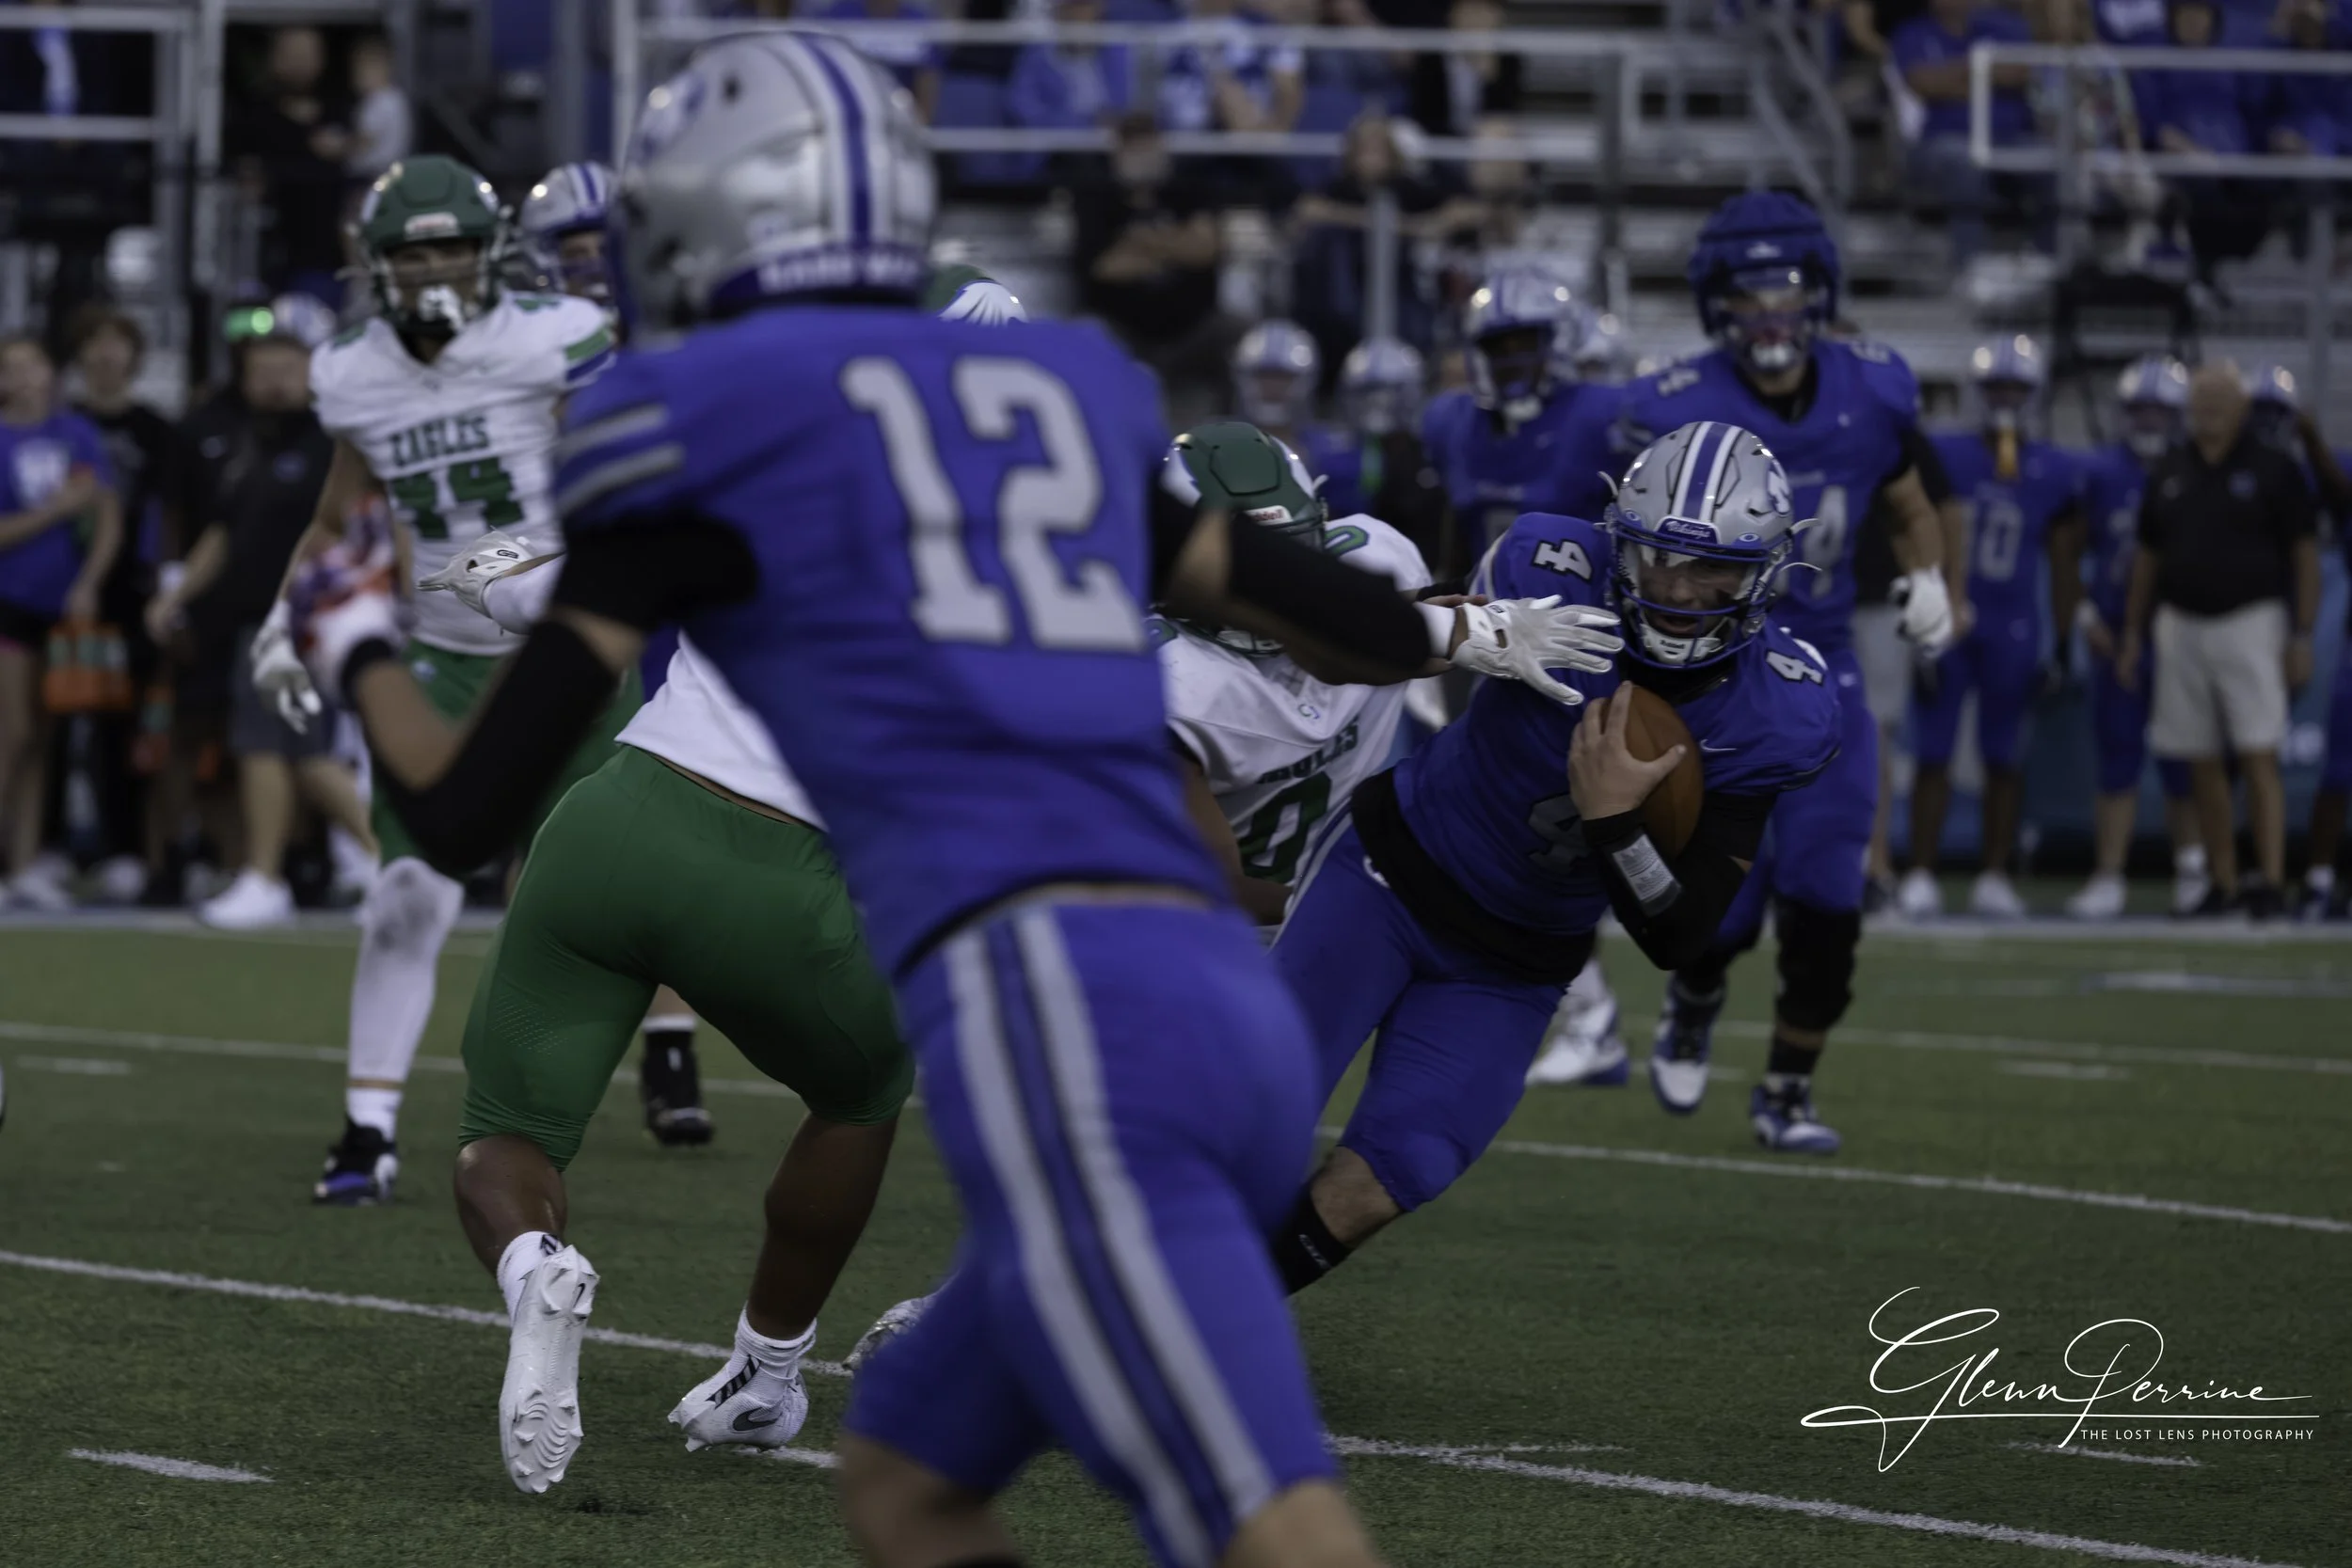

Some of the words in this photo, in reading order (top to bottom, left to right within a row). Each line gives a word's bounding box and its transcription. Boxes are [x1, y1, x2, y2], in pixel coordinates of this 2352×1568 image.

[390, 414, 489, 467] EAGLES
[391, 457, 523, 539] 44
[840, 356, 1150, 653] 12
[1532, 539, 1594, 583] 4
[1765, 649, 1824, 686] 4
[1237, 771, 1331, 884] 0
